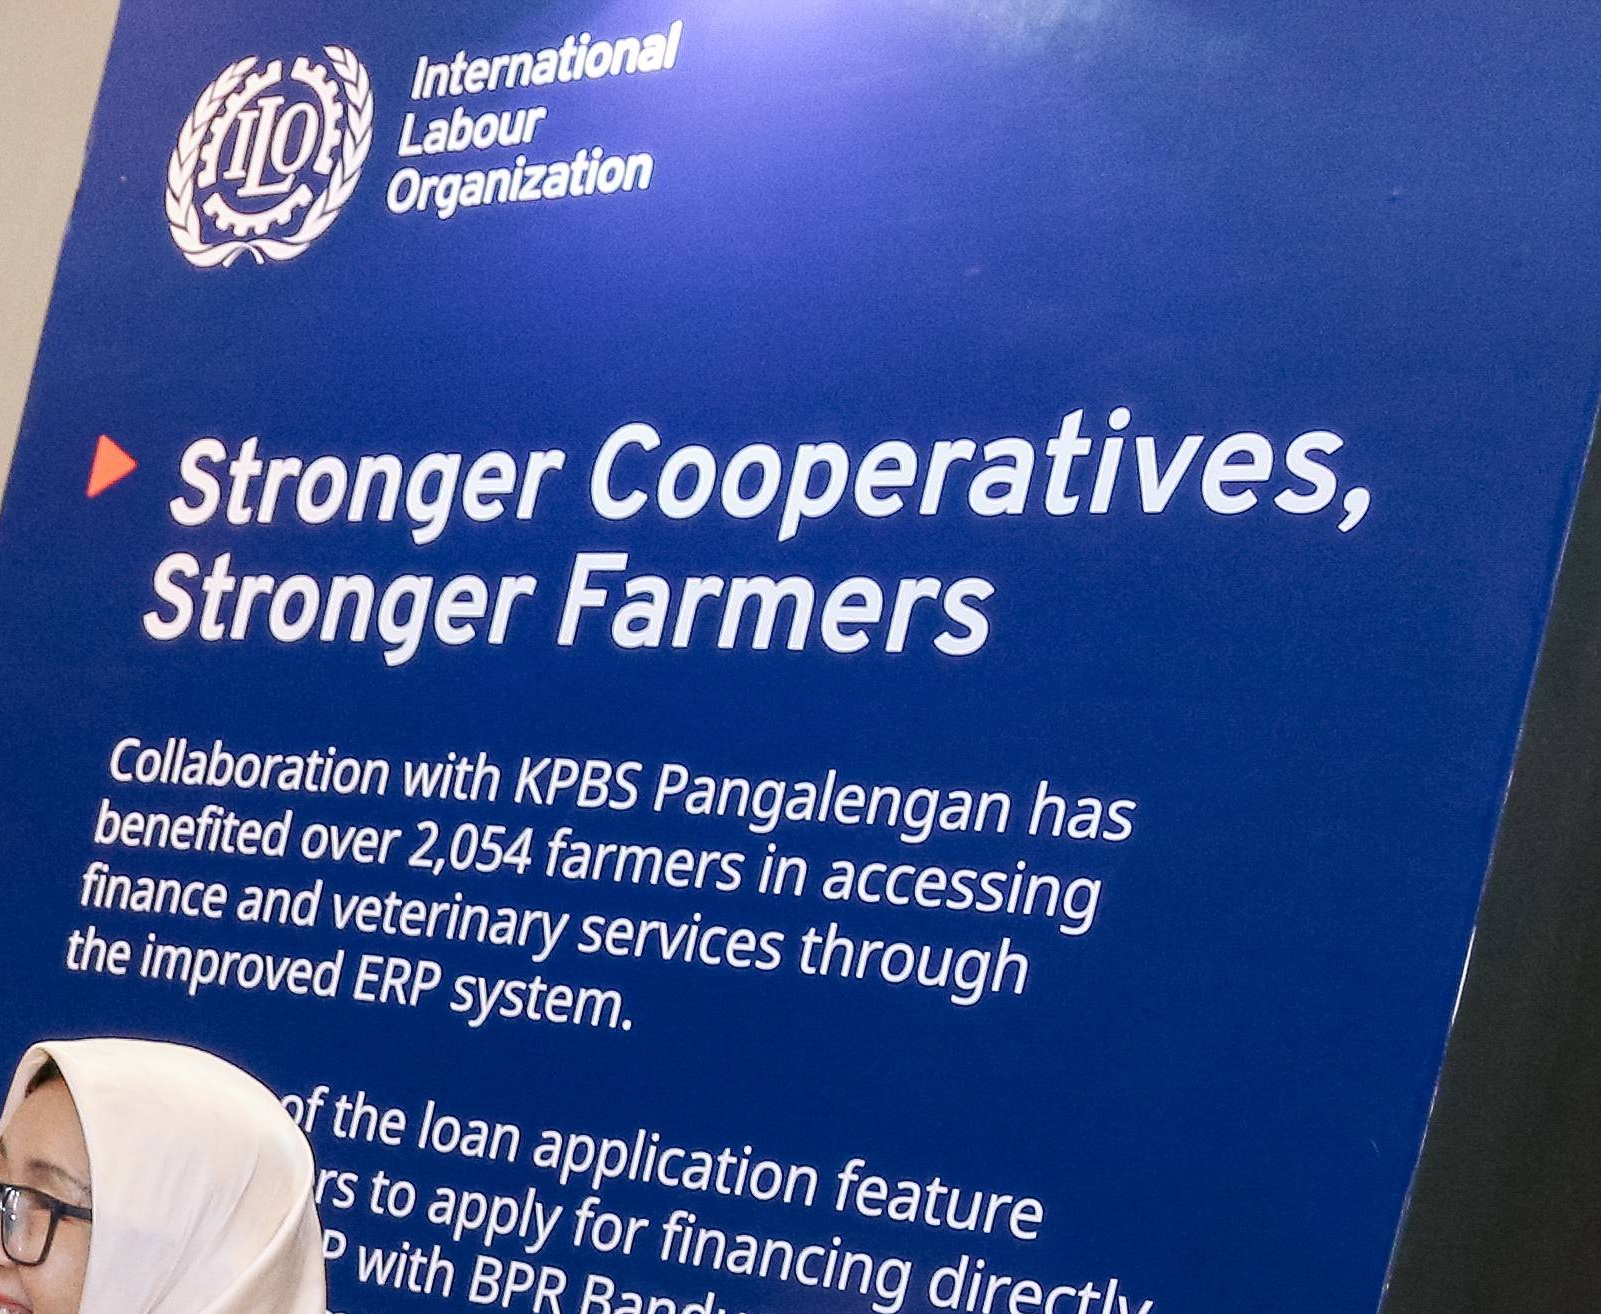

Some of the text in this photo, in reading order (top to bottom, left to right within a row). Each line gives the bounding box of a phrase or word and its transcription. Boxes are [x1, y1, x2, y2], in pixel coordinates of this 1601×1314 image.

[410, 19, 684, 100] International
[223, 96, 320, 198] ILO
[385, 145, 655, 221] Organization
[396, 105, 549, 158] Labour
[168, 406, 1372, 546] Stronger Cooperatives,
[142, 551, 996, 668] Stronger Farmers
[108, 736, 1138, 845] Collaboration with KPBS Pangalengan has
[92, 797, 1103, 937] benefited over 2,054 farmers in accessing
[65, 924, 633, 1032] the improved ERP system.
[79, 860, 1029, 1007] finance and veterinary services through
[282, 1085, 1045, 1241] of the loan application feature
[369, 1169, 417, 1219] to
[426, 1186, 565, 1255] apply
[572, 1195, 651, 1256] for
[357, 1240, 456, 1299] with
